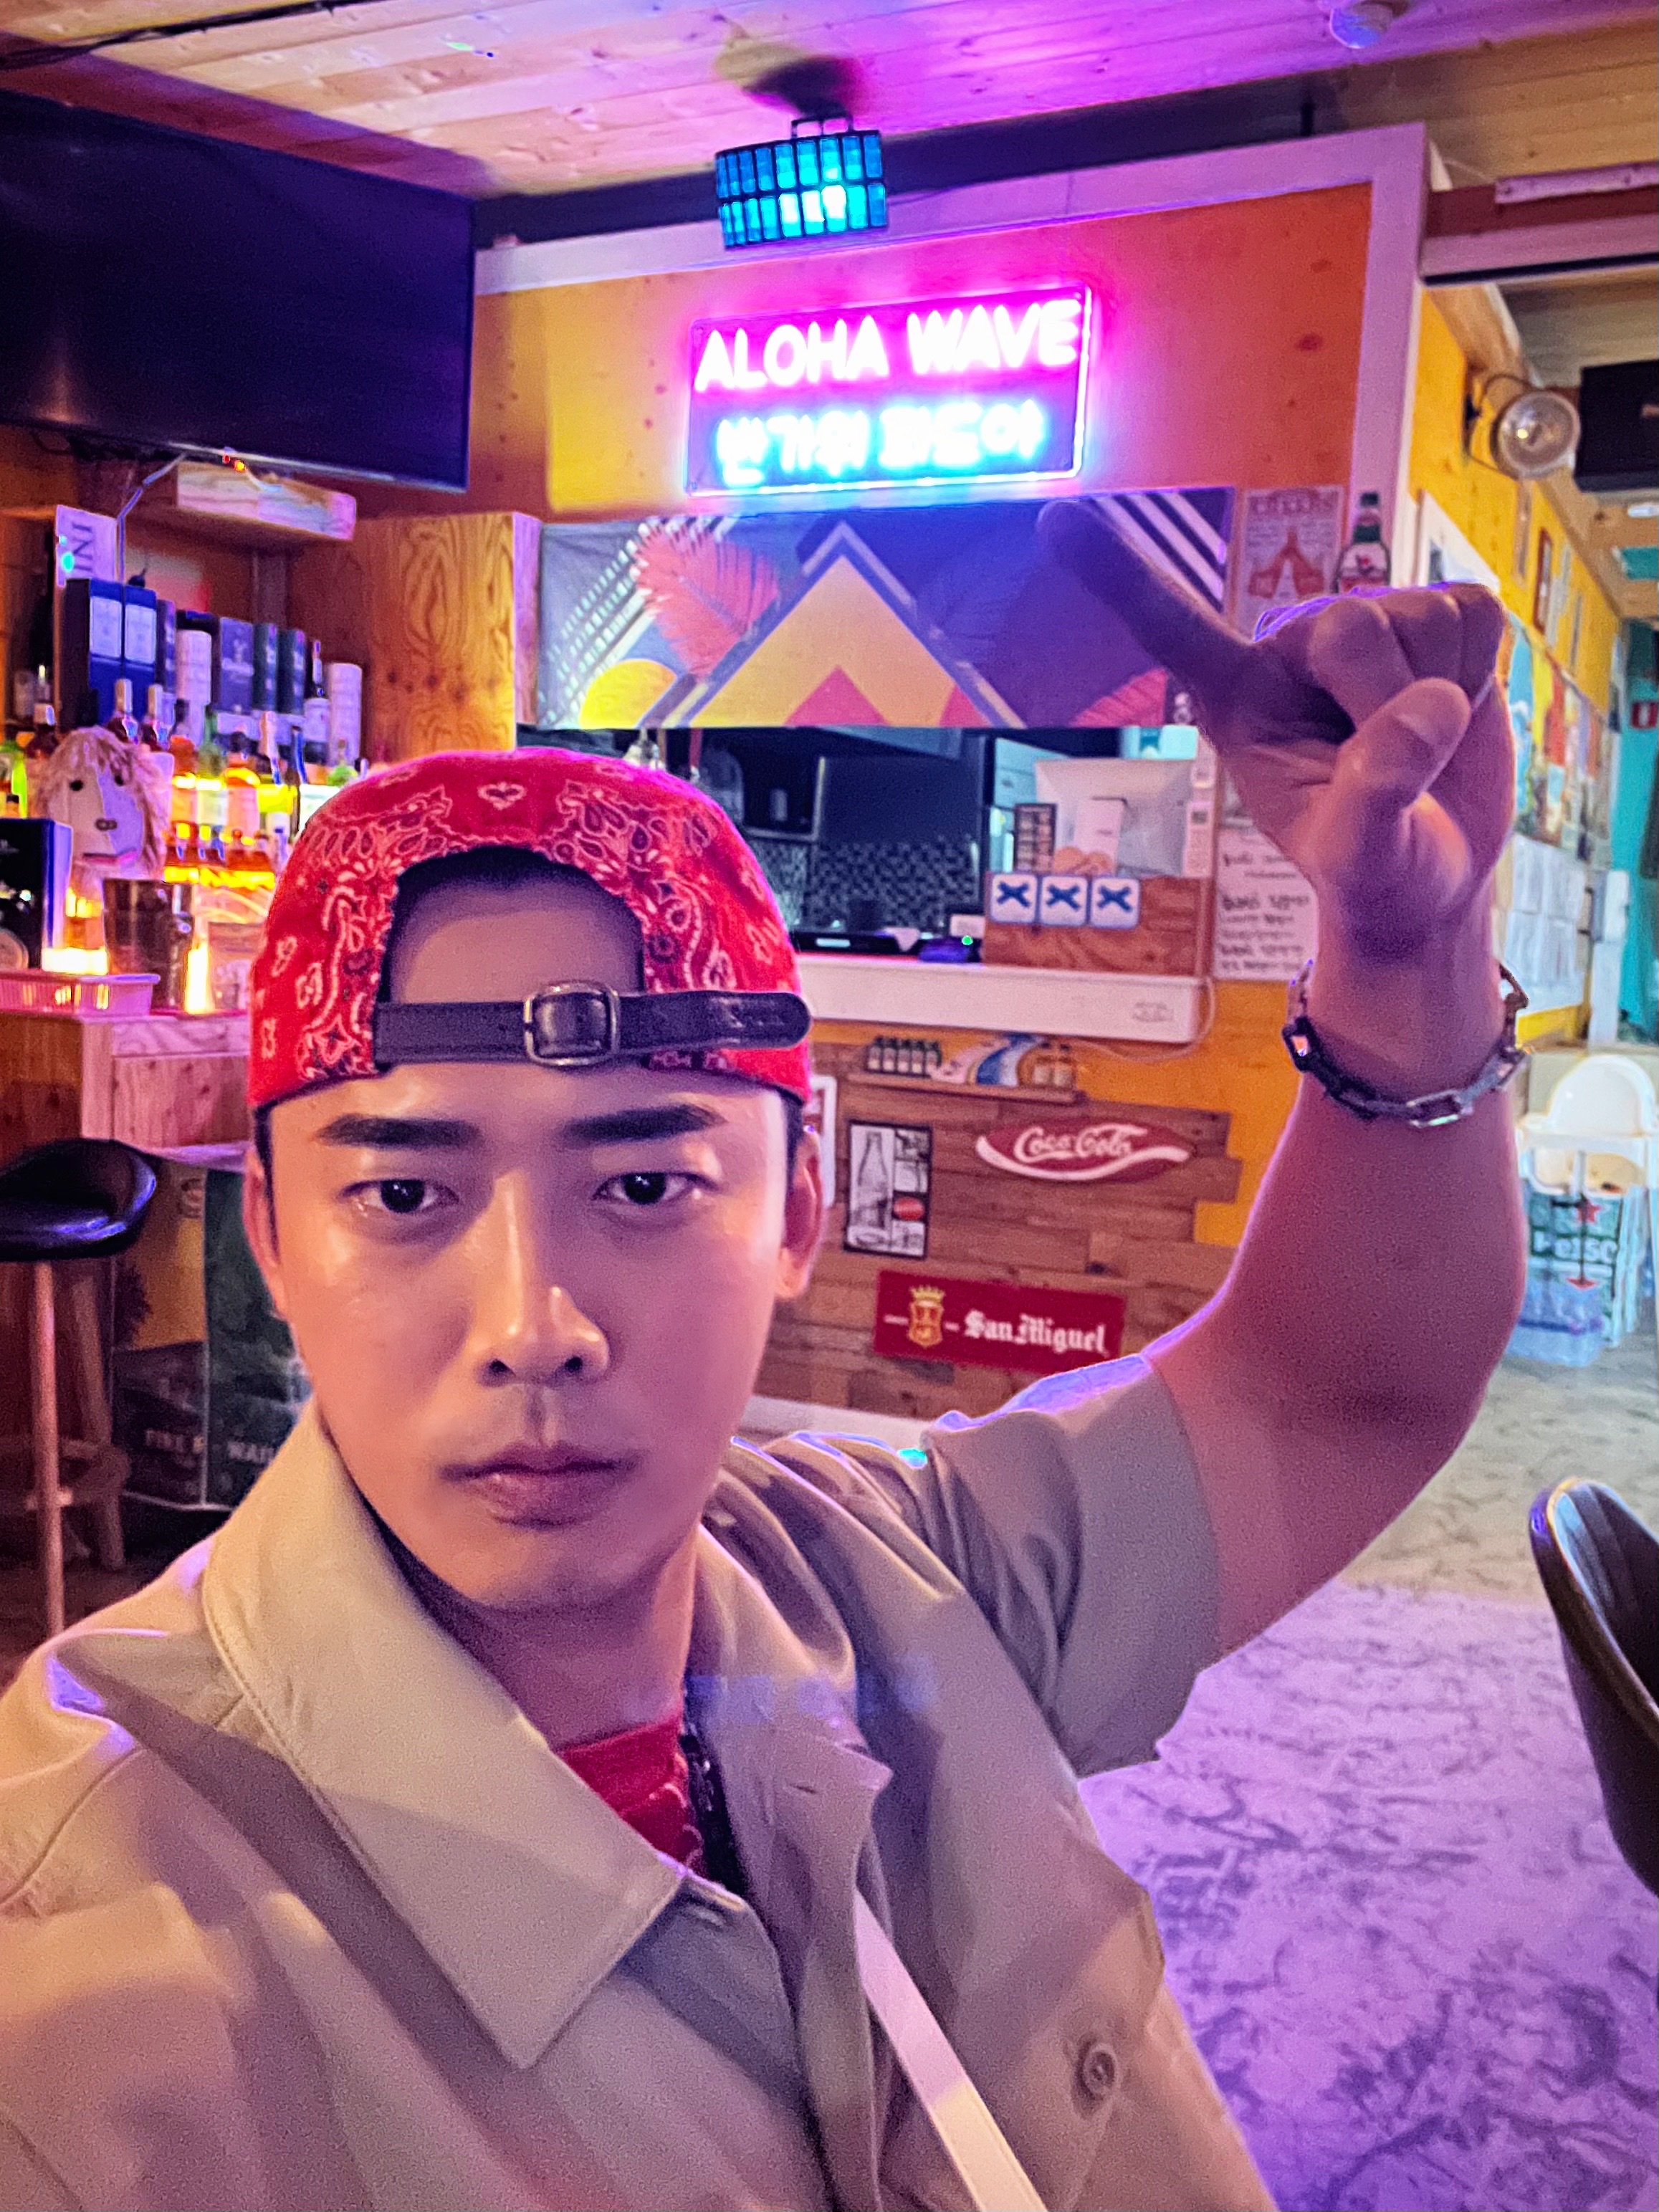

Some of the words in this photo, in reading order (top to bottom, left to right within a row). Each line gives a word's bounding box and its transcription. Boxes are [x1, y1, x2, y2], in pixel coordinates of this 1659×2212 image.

[694, 315, 889, 391] ALOHA
[907, 300, 1081, 374] WAVE
[965, 1309, 1013, 1341] San
[1014, 1313, 1106, 1354] Miguel
